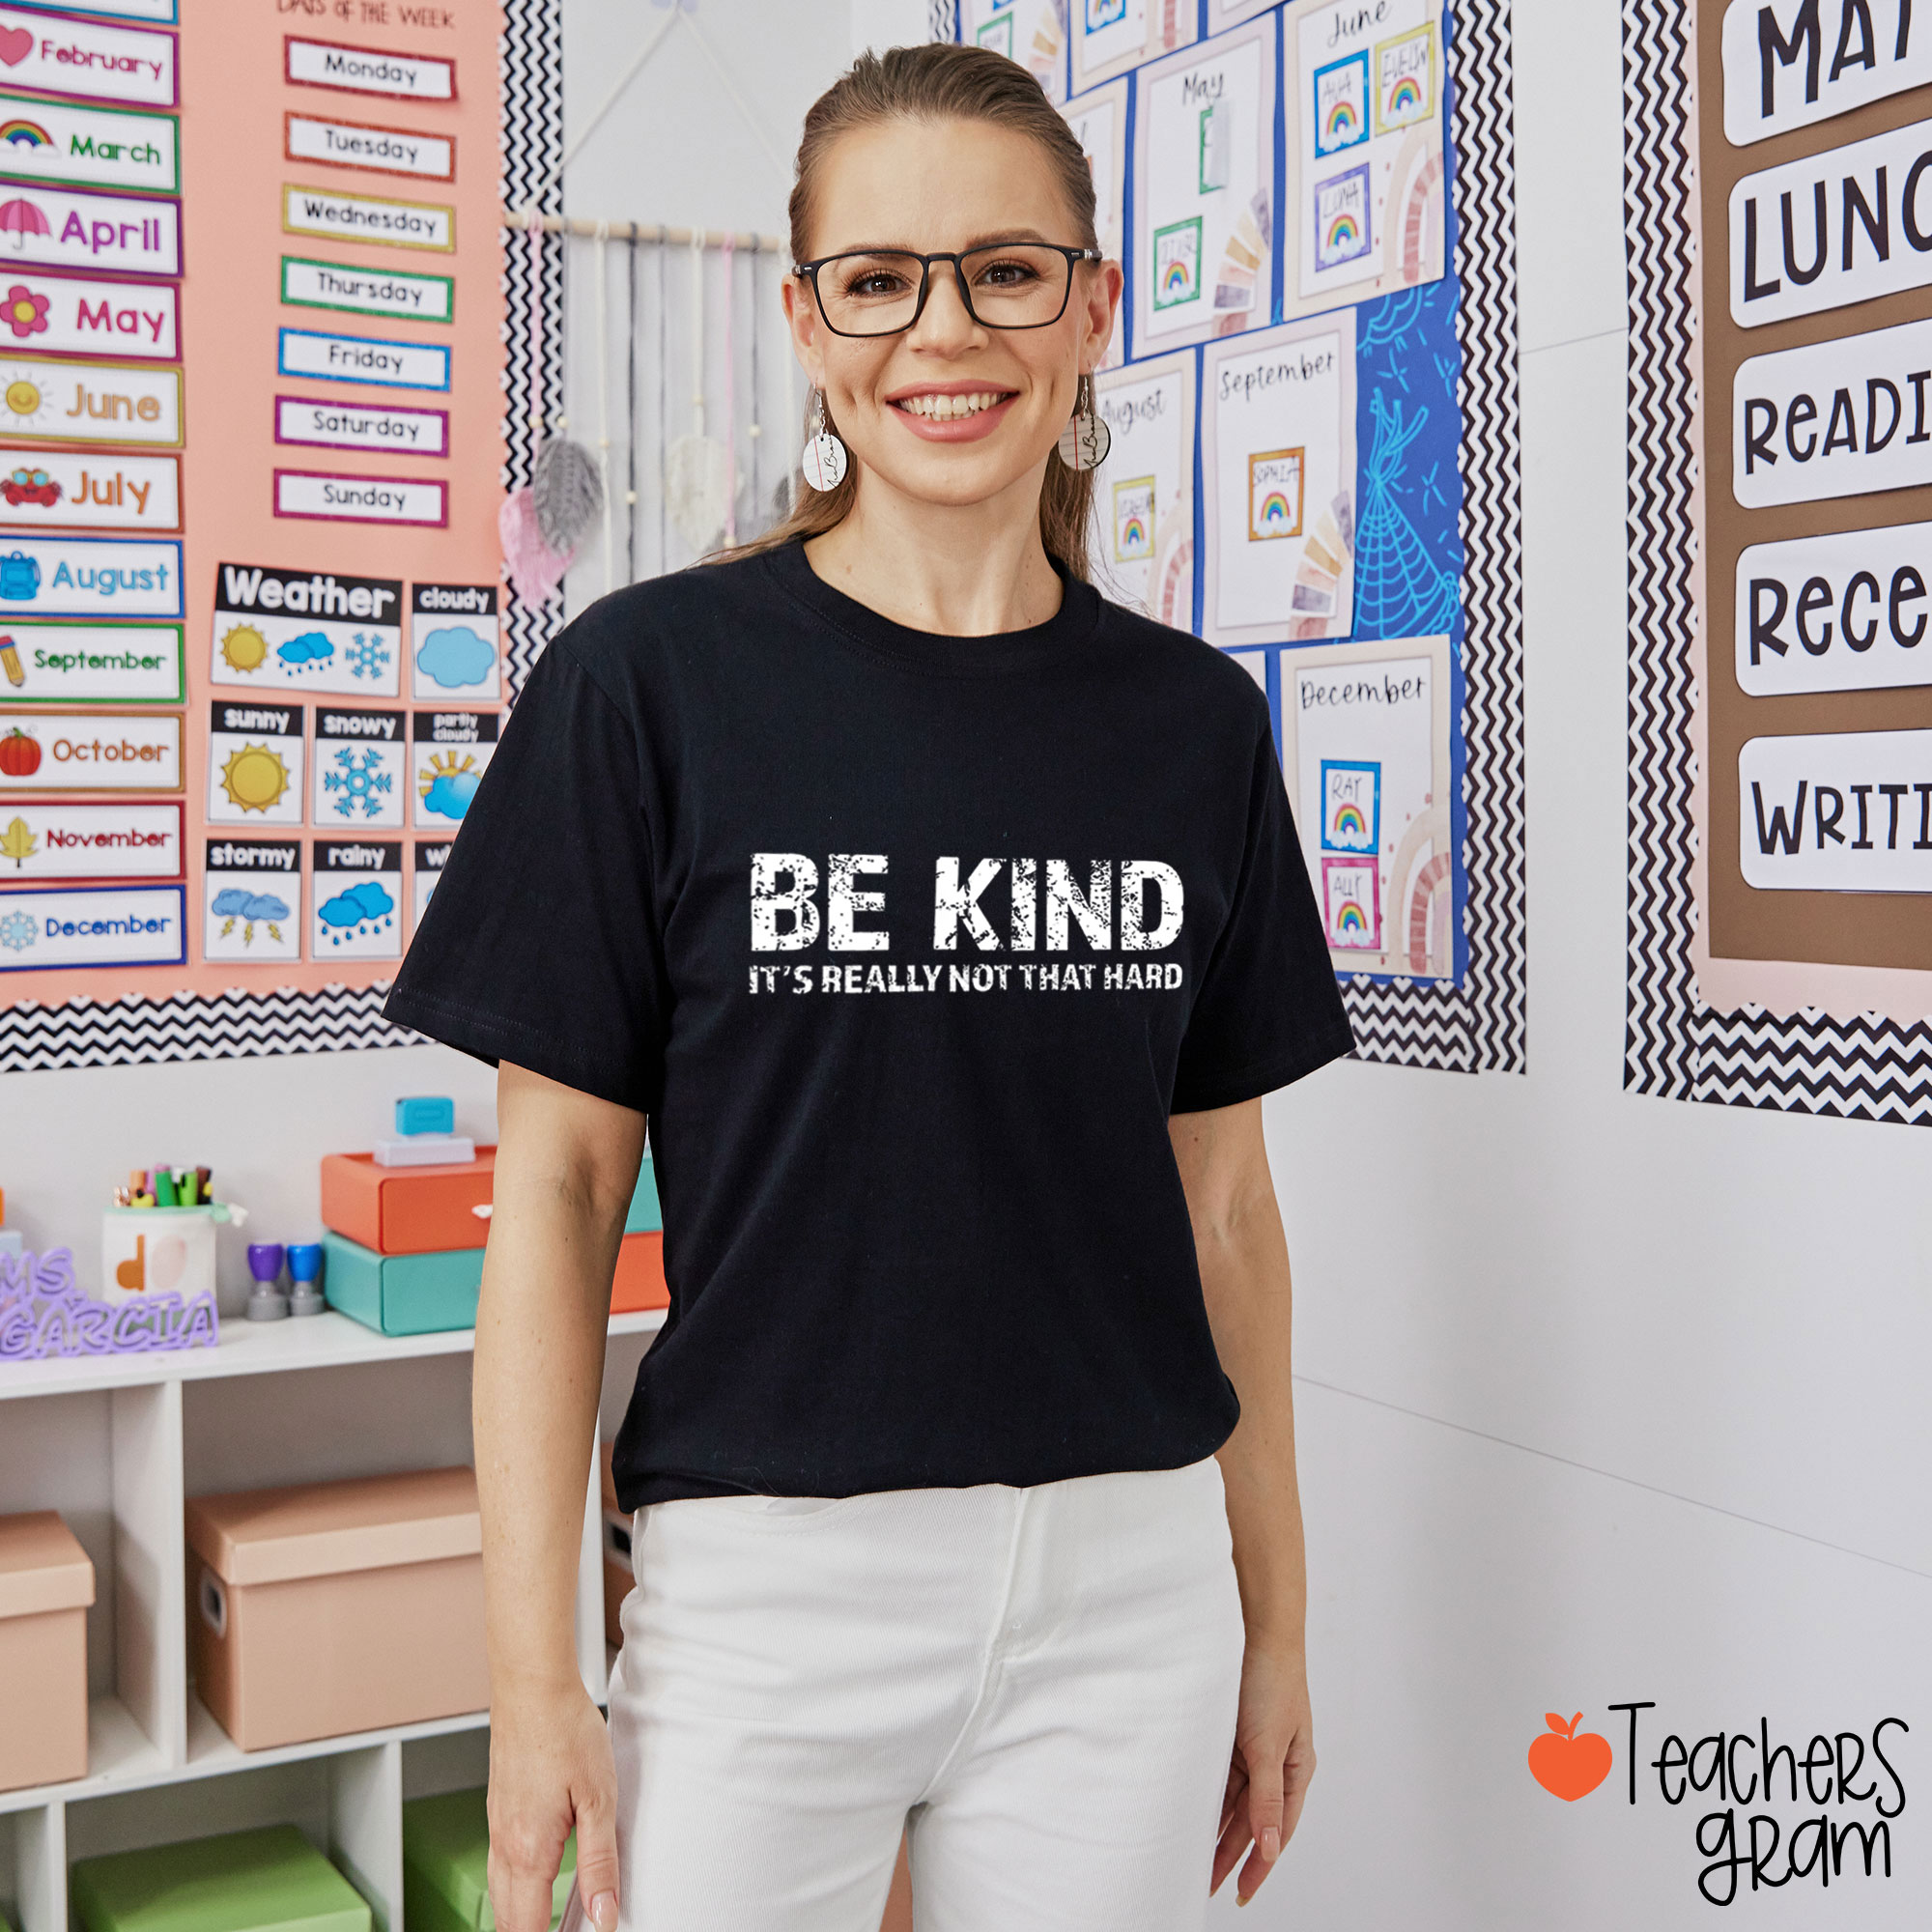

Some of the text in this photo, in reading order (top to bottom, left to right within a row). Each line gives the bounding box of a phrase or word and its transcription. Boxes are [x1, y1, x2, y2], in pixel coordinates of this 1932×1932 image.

[334, 0, 354, 22] OF
[360, 1, 387, 24] THE
[399, 5, 456, 29] WEEK
[1327, 0, 1393, 48] June
[41, 40, 162, 80] February
[325, 52, 416, 88] Monday
[1182, 71, 1223, 108] May
[70, 133, 160, 165] March
[326, 129, 418, 163] Tuesday
[60, 211, 160, 254] April
[304, 199, 437, 236] Wednesday
[318, 272, 422, 305] Thursday
[77, 298, 165, 342] May
[329, 345, 404, 375] Friday
[1218, 351, 1337, 402] September
[67, 384, 160, 421] June
[1101, 388, 1167, 436] August
[314, 412, 419, 440] Saturday
[71, 471, 151, 514] July
[324, 485, 406, 511] Sunday
[52, 561, 168, 594] August
[224, 566, 395, 619] Weather
[419, 586, 490, 614] cloudy
[34, 650, 166, 672] September
[1300, 674, 1426, 710] December
[224, 708, 290, 734] sunny
[324, 714, 395, 738] snowy
[433, 726, 479, 743] cloudy
[434, 713, 478, 730] partly
[53, 740, 169, 763] October
[1331, 774, 1364, 802] RAY
[46, 830, 172, 849] November
[328, 843, 384, 868] rainy
[211, 843, 296, 869] stormy
[751, 853, 1184, 952] BE KIND
[45, 916, 172, 938] December
[749, 963, 1183, 994] IT'S REALLY NOT THAT HARD
[0, 1290, 219, 1362] GARCIA
